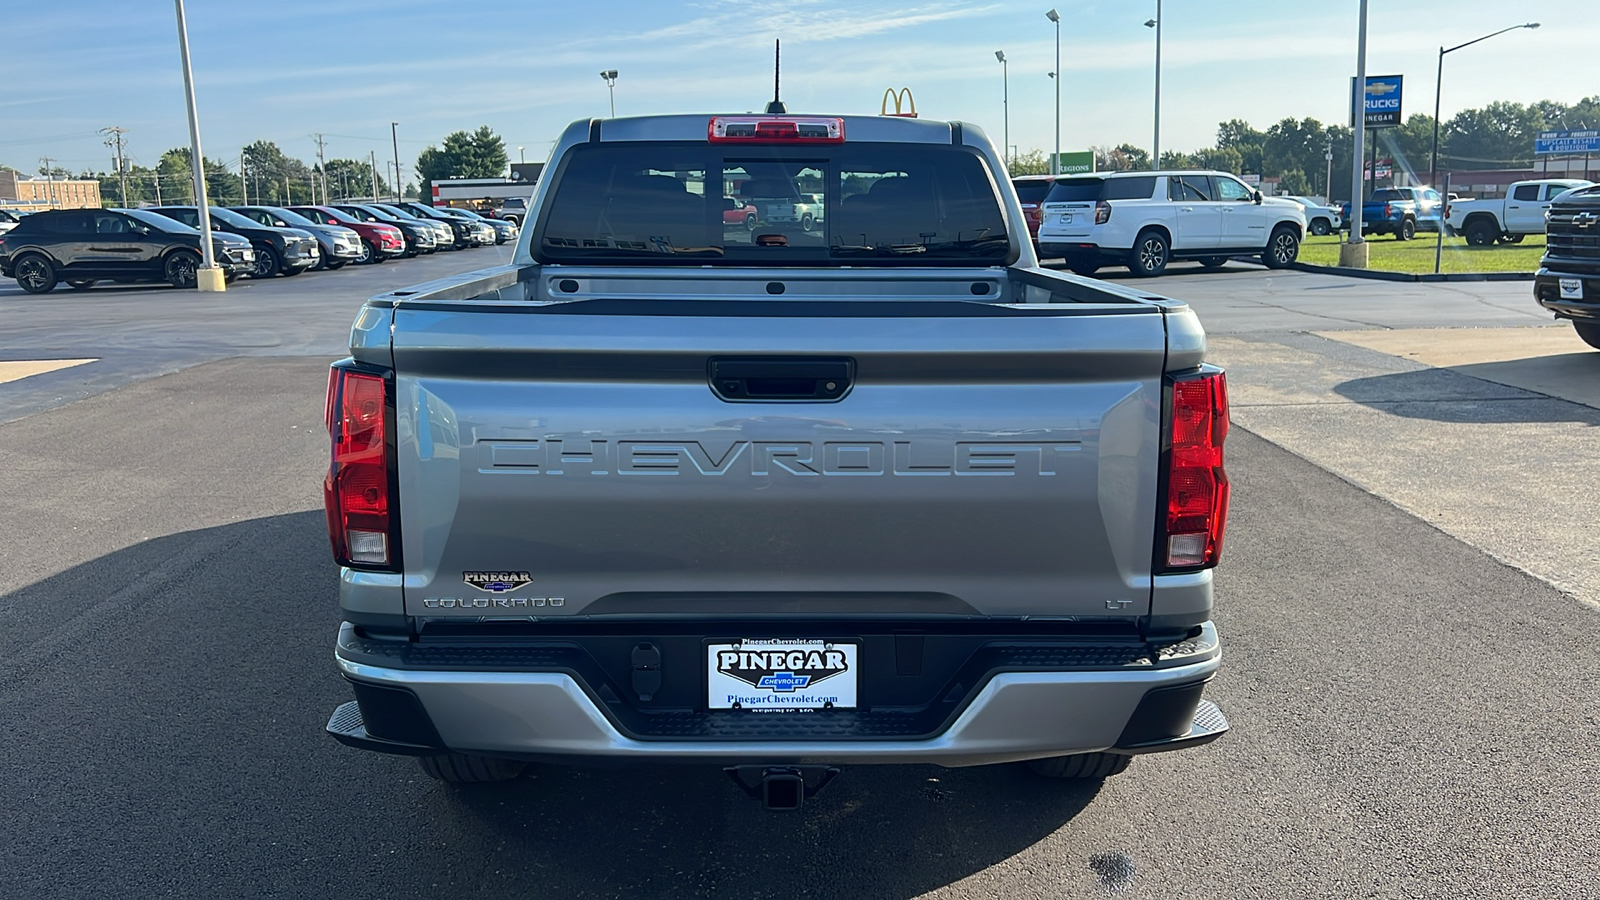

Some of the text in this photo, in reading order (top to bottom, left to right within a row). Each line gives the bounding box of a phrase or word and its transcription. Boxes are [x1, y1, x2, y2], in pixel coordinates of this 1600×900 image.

[1365, 99, 1399, 108] RUCKS
[477, 439, 1082, 475] CHEVROLET
[463, 571, 532, 582] PINEGAR
[423, 597, 565, 608] COLORADO
[1105, 600, 1133, 609] LT
[742, 638, 824, 646] PinegarChevrolet.com
[720, 652, 845, 670] PINEGAR
[727, 695, 838, 705] PinegarChevrolet.com
